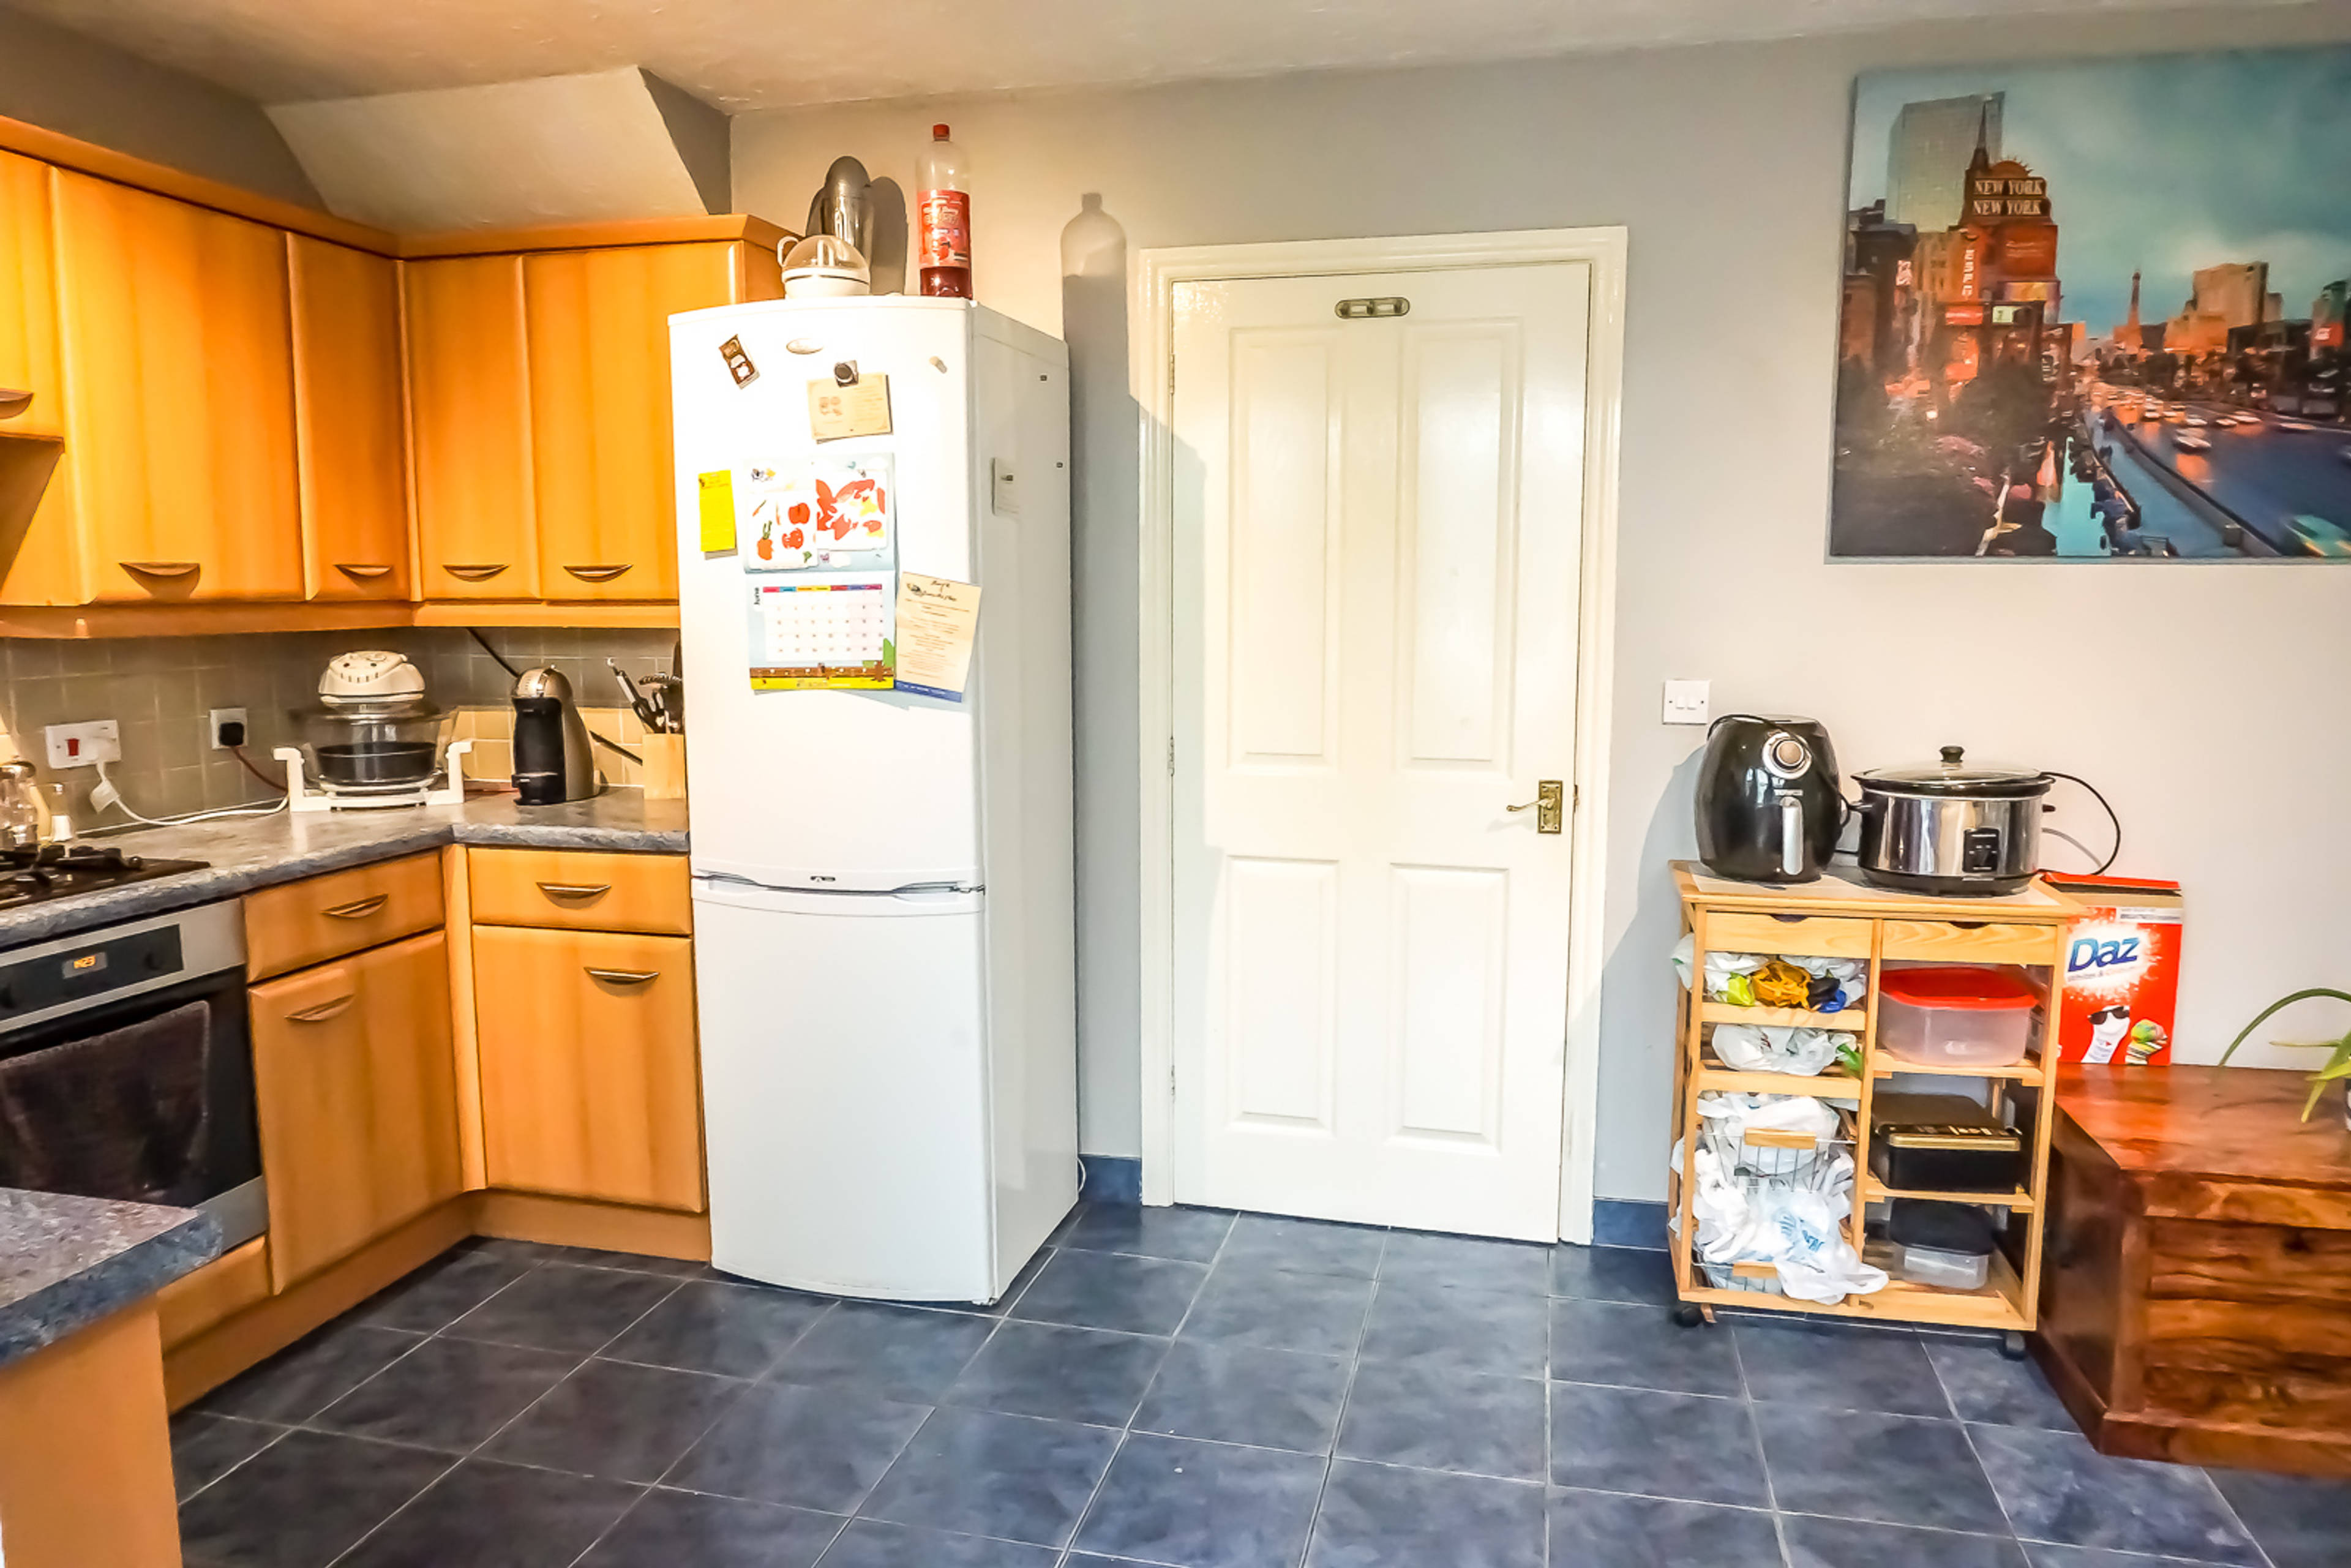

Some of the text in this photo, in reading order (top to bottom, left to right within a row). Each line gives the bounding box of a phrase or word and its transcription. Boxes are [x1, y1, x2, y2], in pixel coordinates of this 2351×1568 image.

[1974, 179, 2043, 195] NEW YORK
[1973, 200, 2042, 215] NEW YORK
[2068, 937, 2140, 972] Daz
